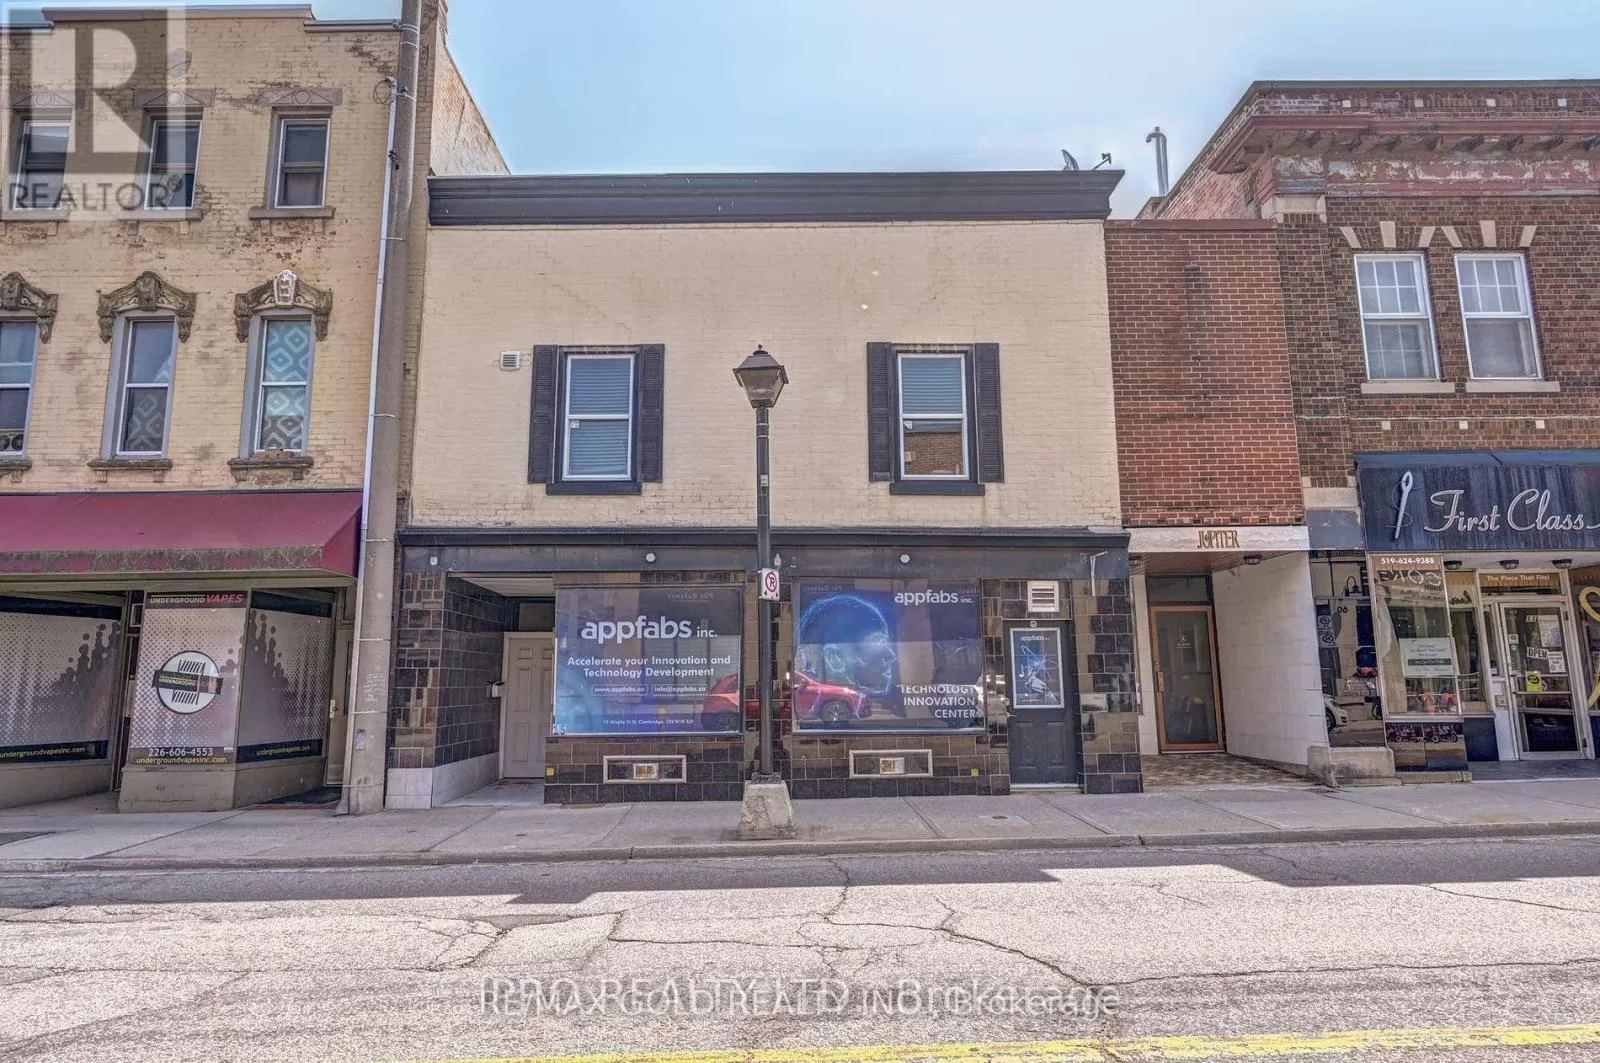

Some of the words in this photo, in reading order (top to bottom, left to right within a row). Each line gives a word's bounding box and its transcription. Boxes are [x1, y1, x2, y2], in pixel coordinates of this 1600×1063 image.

[1424, 489, 1500, 532] First
[1507, 488, 1584, 531] Class
[1197, 530, 1240, 549] JUPITER
[206, 594, 244, 603] VAPES
[894, 589, 959, 606] appfabs
[581, 615, 692, 644] appfabs
[697, 626, 718, 638] inc.
[1528, 649, 1548, 659] OPEN
[567, 656, 622, 665] Accelerate
[625, 658, 649, 667] your
[651, 656, 708, 665] Innovation
[710, 655, 731, 665] and
[583, 667, 642, 678] Technology
[645, 667, 714, 678] Development
[901, 685, 976, 693] TECHNOLOGY
[903, 697, 975, 706] INNOVATION
[934, 709, 976, 718] CENTER
[148, 747, 213, 757] 226-606-4553
[136, 756, 227, 764] undergroundvapesinc.com
